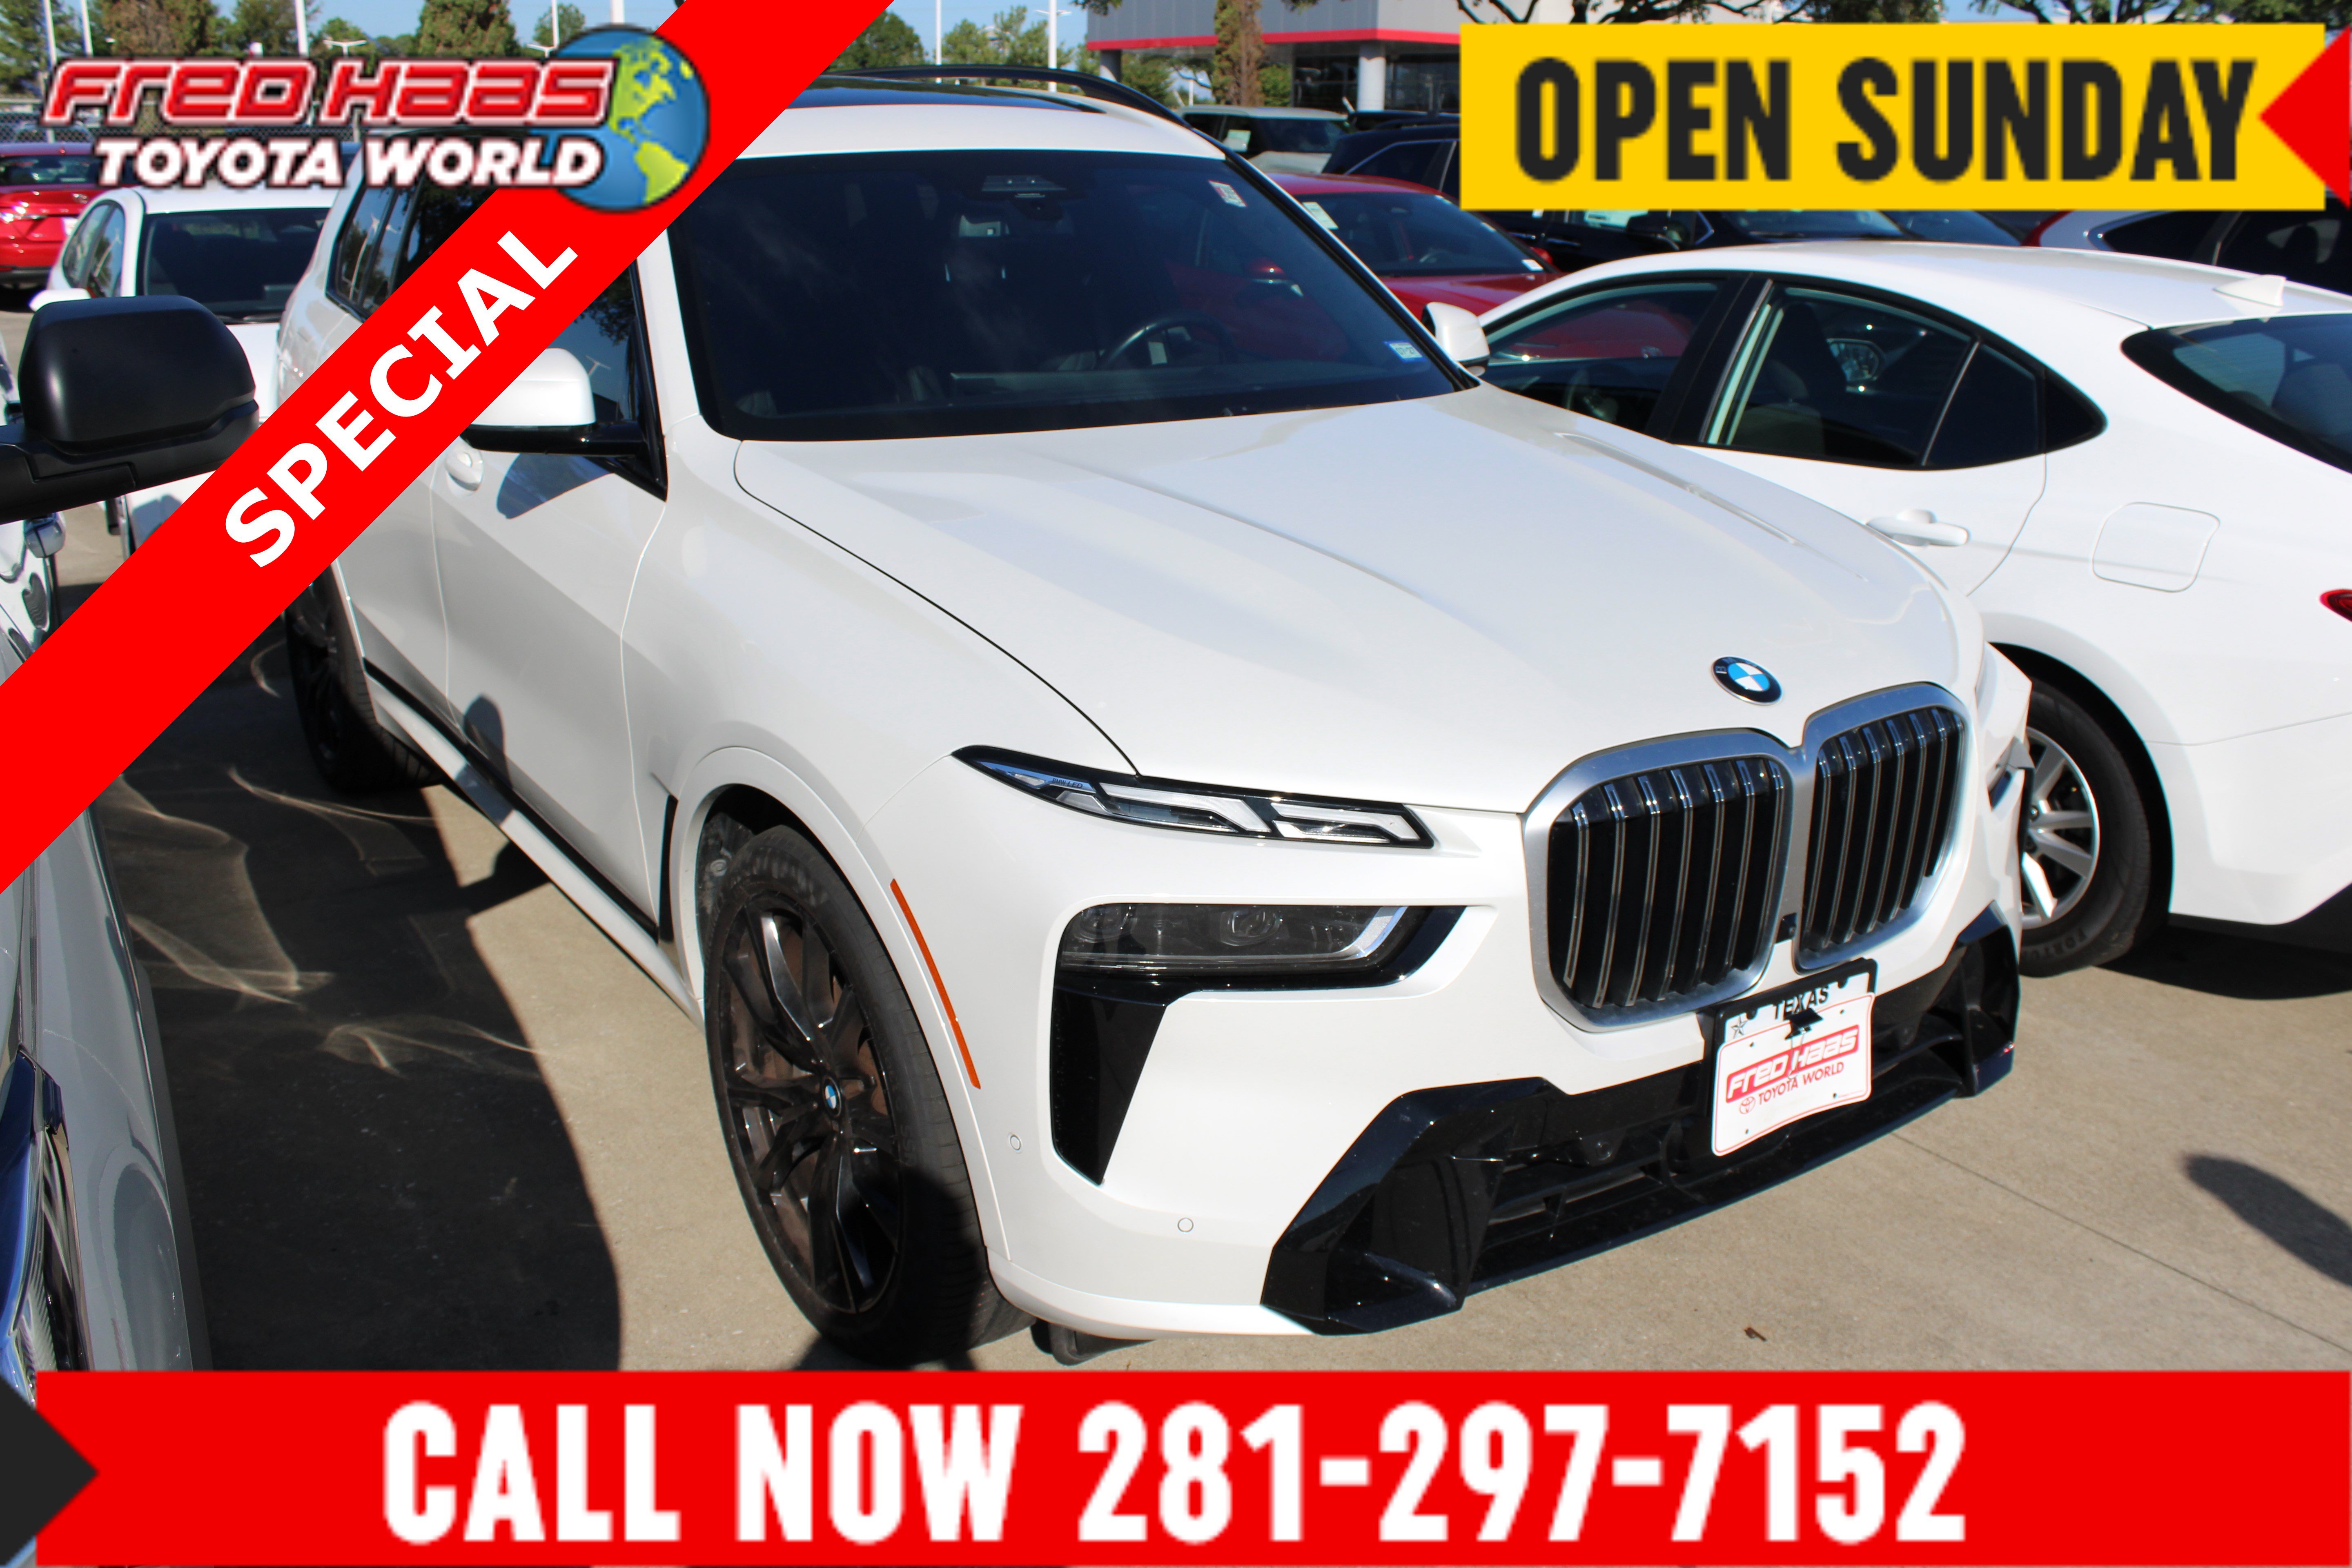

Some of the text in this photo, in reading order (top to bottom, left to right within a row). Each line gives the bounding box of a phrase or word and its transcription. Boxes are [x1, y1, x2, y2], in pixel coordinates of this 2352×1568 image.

[1773, 987, 1829, 1020] TEXAS
[1759, 1062, 1844, 1105] TOYOTA WORLD
